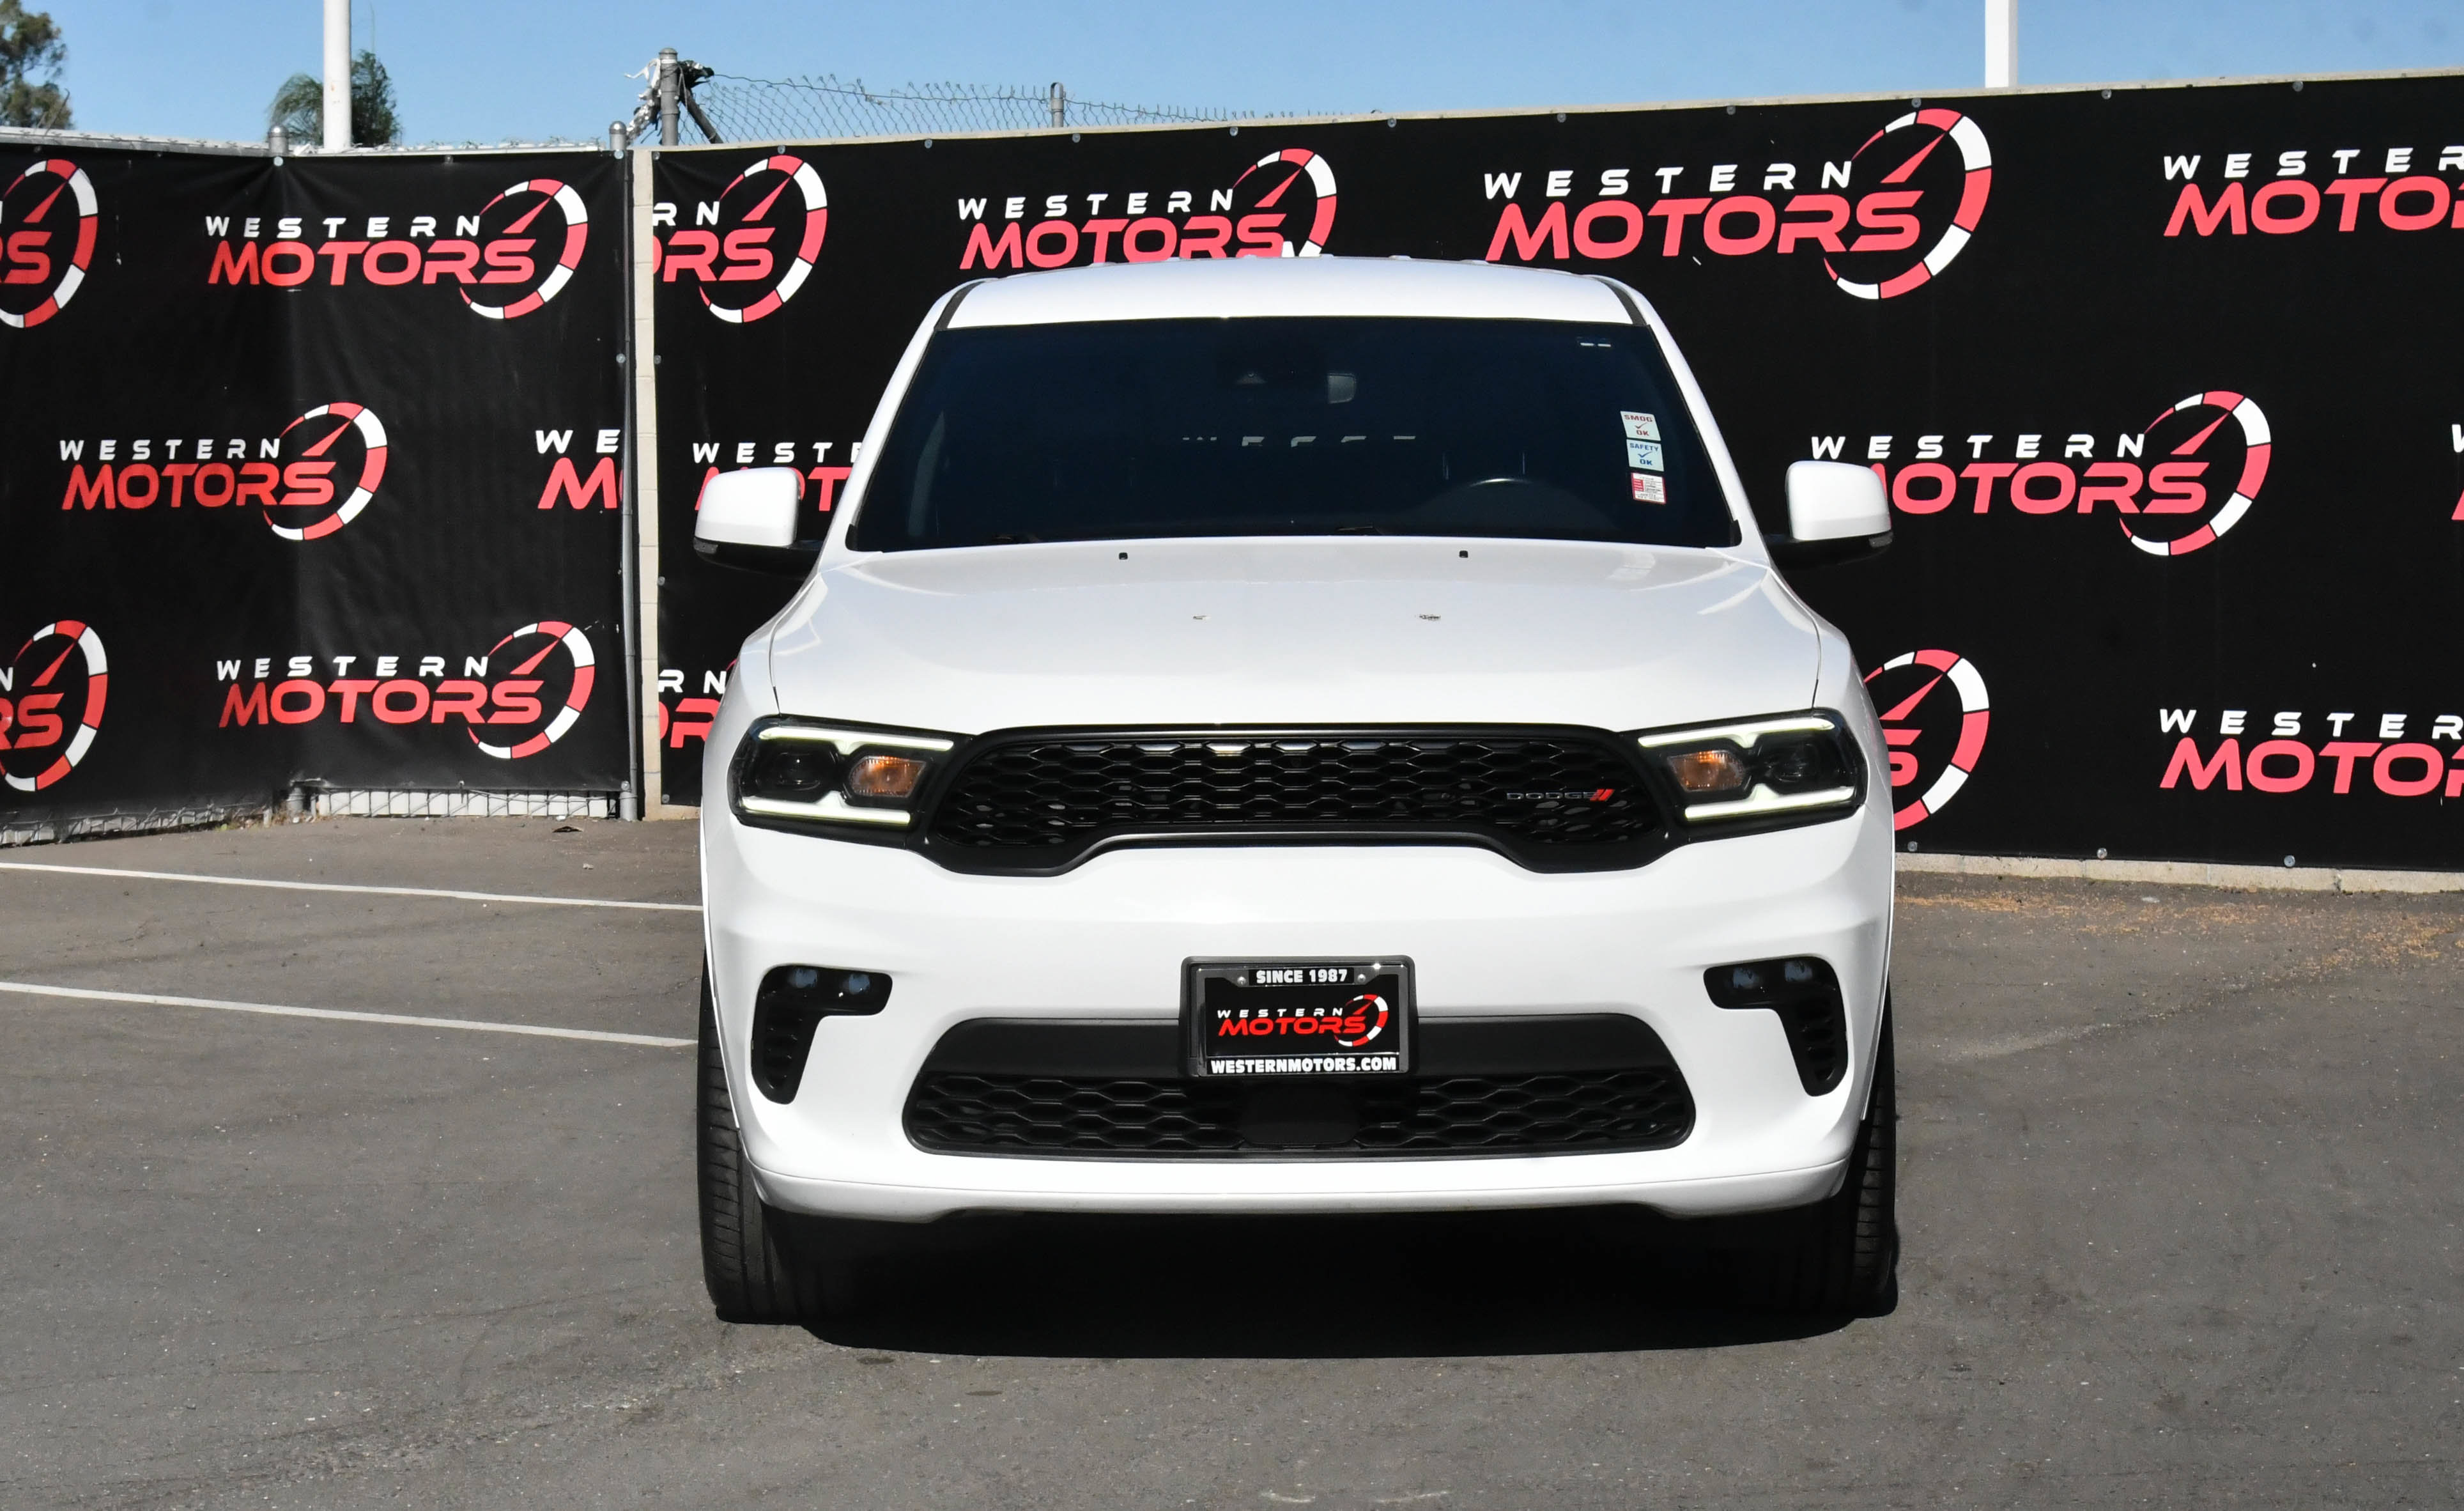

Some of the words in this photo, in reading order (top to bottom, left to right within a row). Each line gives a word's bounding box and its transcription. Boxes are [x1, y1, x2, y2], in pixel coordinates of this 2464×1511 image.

[1484, 160, 1852, 200] WESTERN
[958, 188, 1233, 221] WESTERN
[2163, 175, 2464, 237] MOTO
[205, 215, 481, 239] WESTERN
[1485, 190, 1924, 261] MOTORS
[959, 213, 1287, 270] MOTORS
[208, 238, 537, 287] MOTORS
[59, 438, 281, 461] WESTERN
[1629, 443, 1658, 451] SAFETY
[1811, 433, 2146, 460] WESTERN
[61, 461, 337, 510] MOTORS
[1870, 461, 2211, 515] OTORS
[217, 656, 489, 681] WESTERN
[219, 678, 544, 727] MOTORS
[2159, 708, 2464, 741] WESTER
[1506, 791, 1599, 800] DODGE
[1256, 970, 1304, 984] SINCE
[1309, 968, 1348, 982] 1987
[1217, 1007, 1343, 1019] WESTERN
[1218, 1016, 1366, 1037] MOTORS
[1211, 1057, 1397, 1074] WESTERNMOTORS.COM
